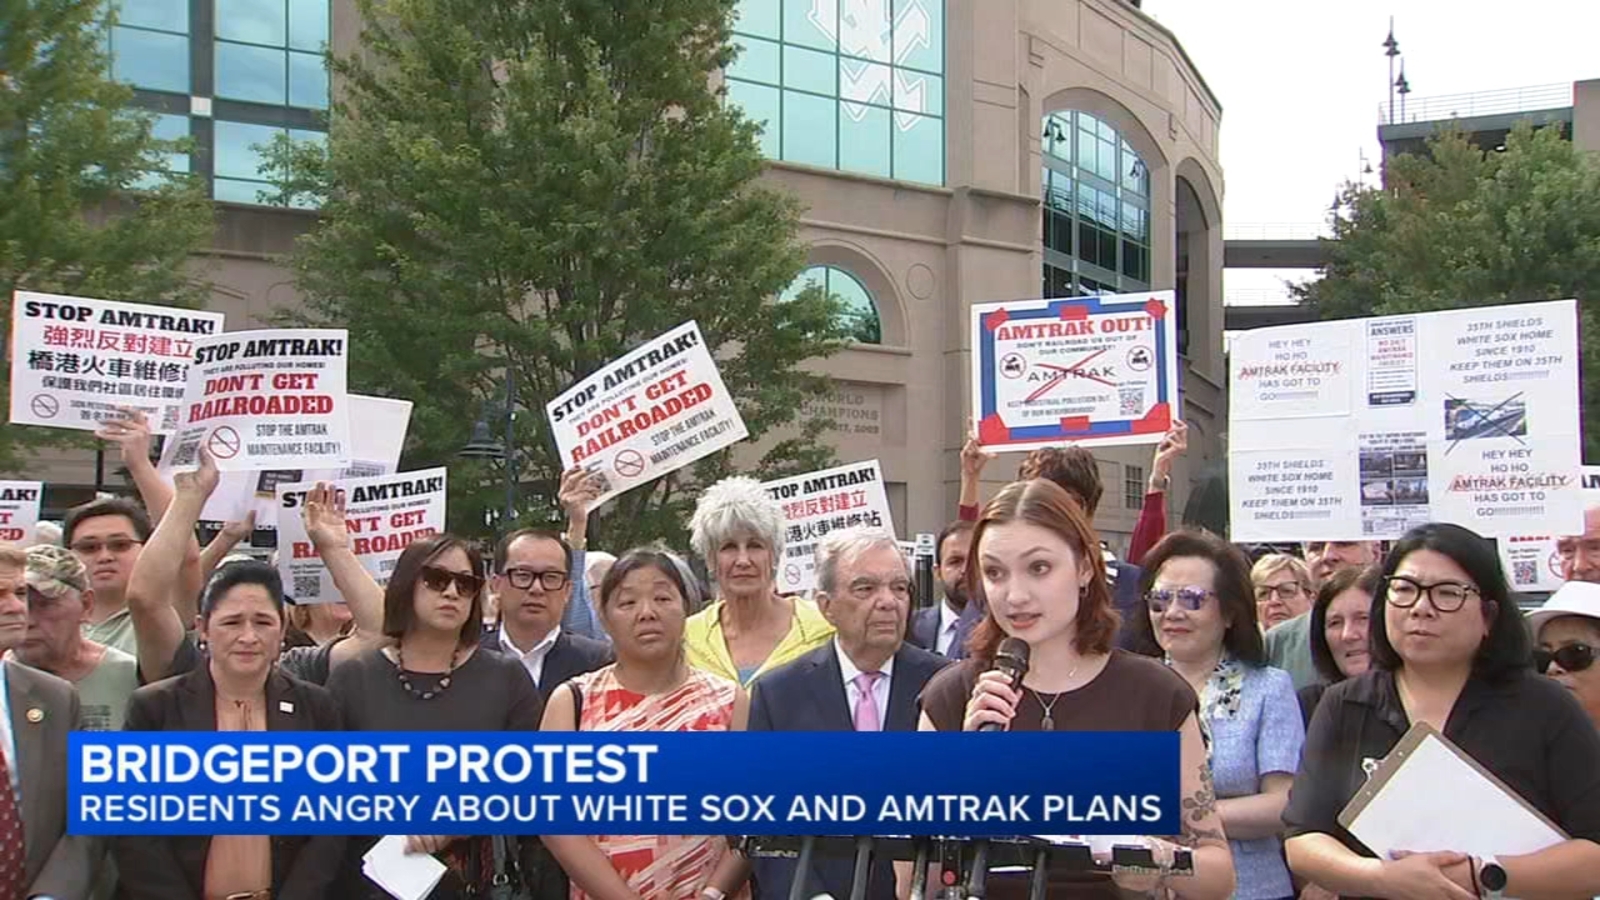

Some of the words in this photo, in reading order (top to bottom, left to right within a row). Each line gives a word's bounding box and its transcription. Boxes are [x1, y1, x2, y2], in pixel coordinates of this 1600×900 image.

[25, 301, 93, 322] STOP
[100, 309, 214, 335] AMTRAK!
[1495, 317, 1543, 328] SHIELDS
[997, 320, 1094, 341] AMTRAK
[1101, 317, 1152, 334] OUT!
[1371, 325, 1415, 336] ANSWERS
[43, 325, 193, 359] 強烈反對建立
[1269, 341, 1288, 349] HEY
[1292, 339, 1311, 347] HEY
[1457, 334, 1491, 345] WHITE
[1494, 332, 1517, 343] SOX
[1519, 330, 1553, 340] HOME
[195, 342, 240, 365] STOP
[243, 339, 343, 358] AMTRAK!
[1275, 353, 1290, 361] HO
[1476, 346, 1507, 357] SINCE
[27, 349, 189, 382] 橋港火車維修
[1241, 365, 1289, 378] AMTRAK
[1291, 362, 1339, 373] FACILITY
[1450, 362, 1480, 371] KEEP
[1483, 360, 1512, 369] THEM
[1515, 358, 1532, 367] ON
[553, 384, 597, 422] STOP
[603, 331, 698, 391] AMTRAK!
[1027, 366, 1118, 382] AMTRAK
[204, 374, 264, 396] DON'T
[272, 373, 318, 390] GET
[1259, 380, 1280, 388] HAS
[1283, 379, 1304, 387] GOT
[1306, 378, 1320, 386] TO
[188, 395, 334, 423] RAILROADED
[576, 395, 636, 437] DON'T
[645, 369, 688, 401] GET
[256, 424, 276, 437] STOP
[278, 424, 292, 436] THE
[295, 423, 327, 436] AMTRAK
[571, 382, 713, 463] RAILROADED
[651, 431, 670, 446] STOP
[687, 409, 717, 432] AMTRAK
[247, 443, 303, 456] MAINTENANCE
[650, 434, 701, 465] MAINTENANCE
[1482, 450, 1505, 460] HEY
[1508, 449, 1533, 458] HEY
[1283, 460, 1324, 469] SHIELDS
[1491, 464, 1508, 473] HO
[1511, 463, 1529, 472] HO
[771, 483, 799, 501] TOP
[804, 468, 876, 495] AMTRAK!
[1248, 474, 1278, 483] WHITE
[1281, 473, 1302, 482] SOX
[1305, 472, 1333, 481] HOME
[1453, 478, 1506, 489] AMTRAK
[1509, 475, 1567, 487] FACILITY
[352, 476, 442, 502] AMTRAK!
[1265, 486, 1293, 495] SINCE
[1242, 499, 1268, 508] KEEP
[1271, 498, 1298, 507] THEM
[1300, 498, 1315, 506] ON
[1474, 494, 1498, 502] HAS
[1501, 492, 1526, 501] GOT
[1530, 492, 1546, 500] TO
[391, 510, 426, 528] GET
[785, 510, 882, 543] 港火車維修站
